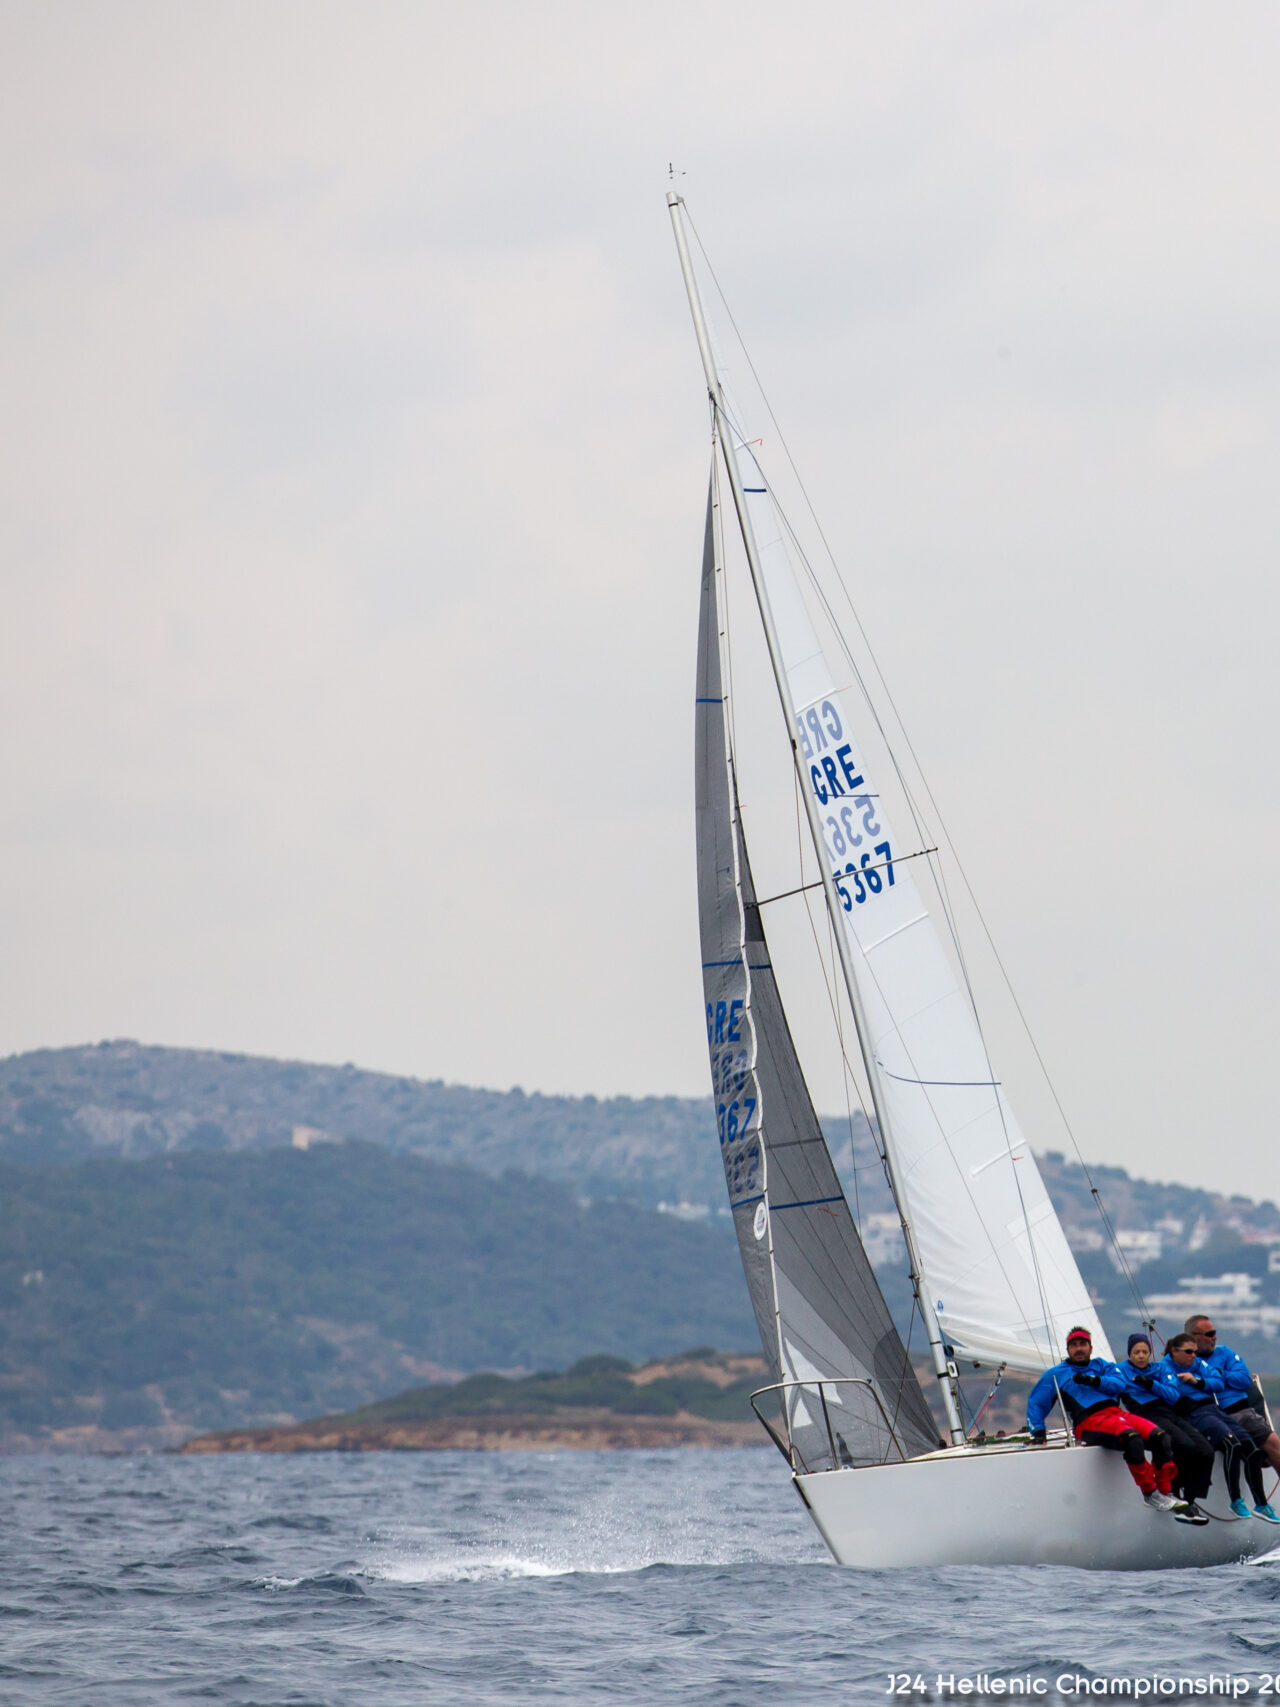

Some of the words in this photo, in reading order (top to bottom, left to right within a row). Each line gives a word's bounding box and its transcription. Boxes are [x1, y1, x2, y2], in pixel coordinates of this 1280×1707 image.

[810, 743, 864, 805] GRE
[833, 840, 895, 912] 5367
[718, 1098, 756, 1145] 367
